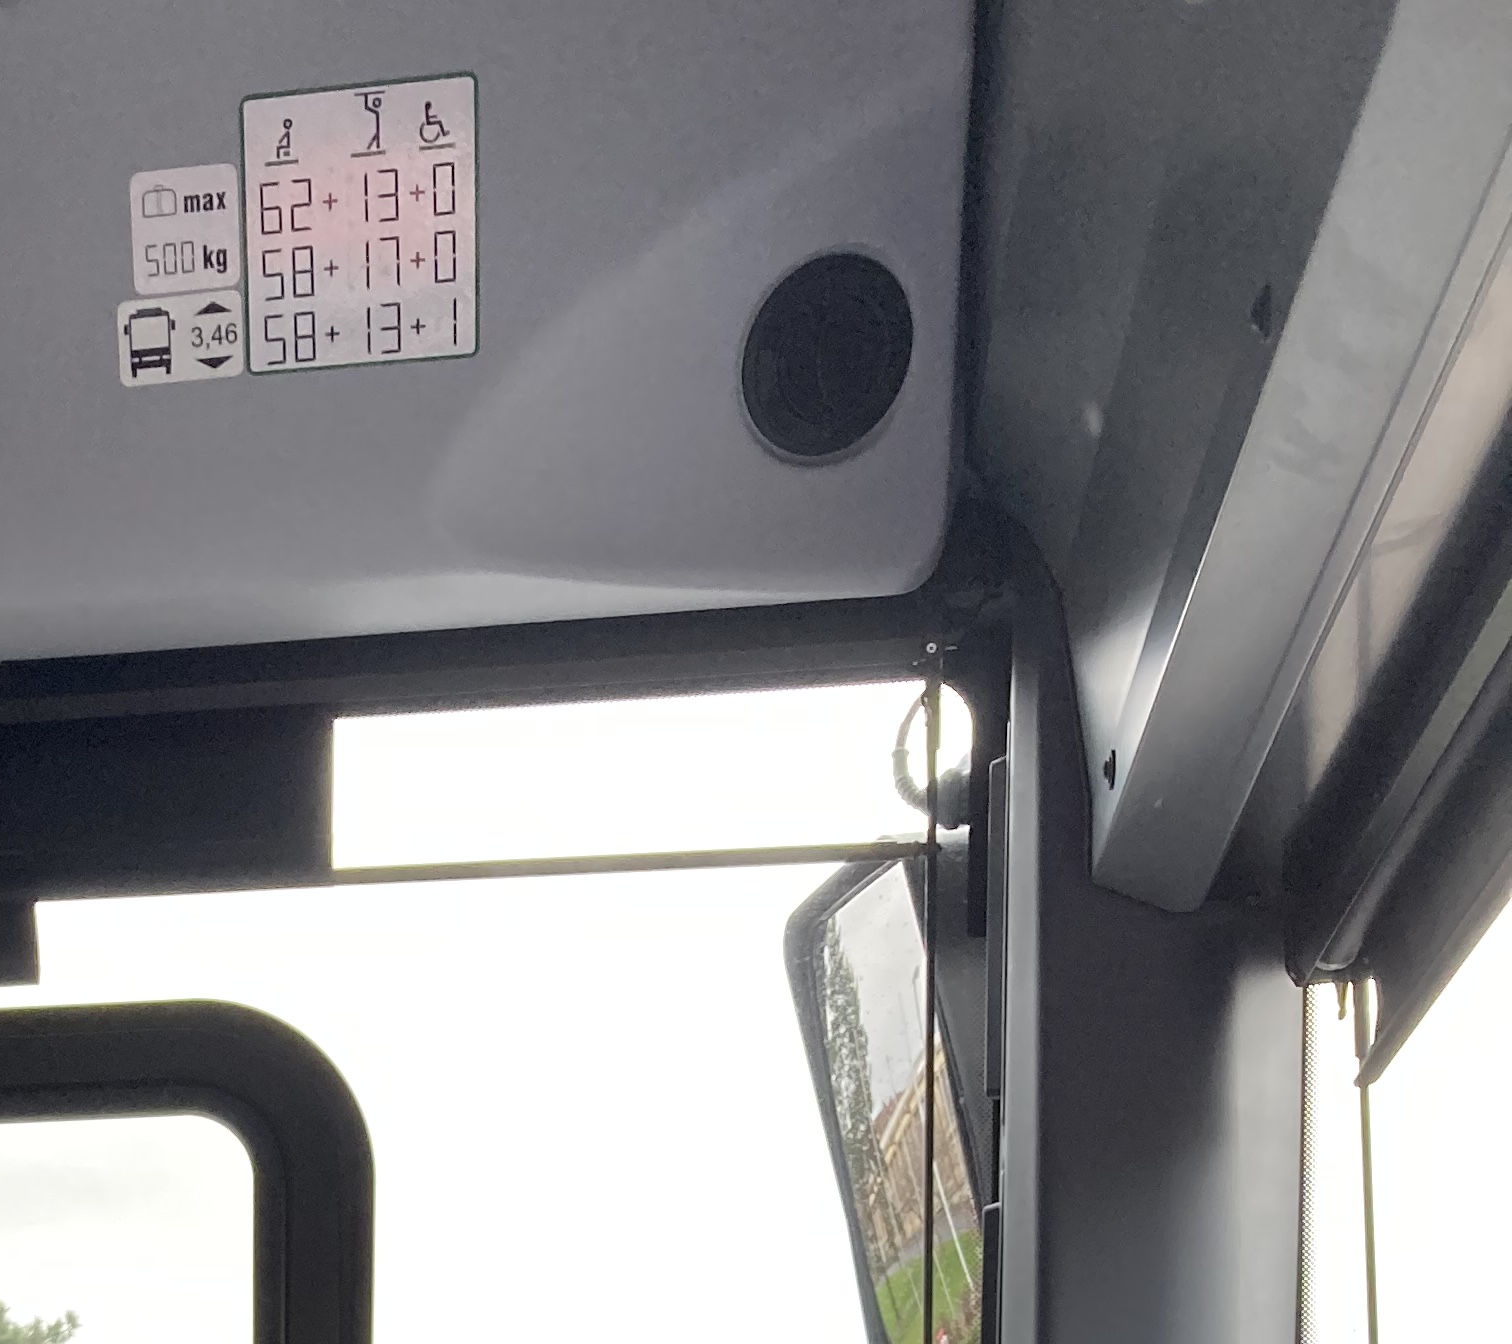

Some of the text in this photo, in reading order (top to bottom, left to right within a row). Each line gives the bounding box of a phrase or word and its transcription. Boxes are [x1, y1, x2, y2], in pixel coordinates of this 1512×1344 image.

[183, 191, 227, 213] max
[259, 178, 312, 235] 62
[363, 169, 400, 222] 13
[433, 162, 456, 216] 0
[145, 240, 228, 277] 500 kg
[262, 245, 314, 301] 58
[366, 236, 401, 289] 17
[434, 230, 457, 283] 0
[191, 323, 238, 350] 3,46
[264, 311, 317, 365] 58
[366, 302, 402, 355] 13
